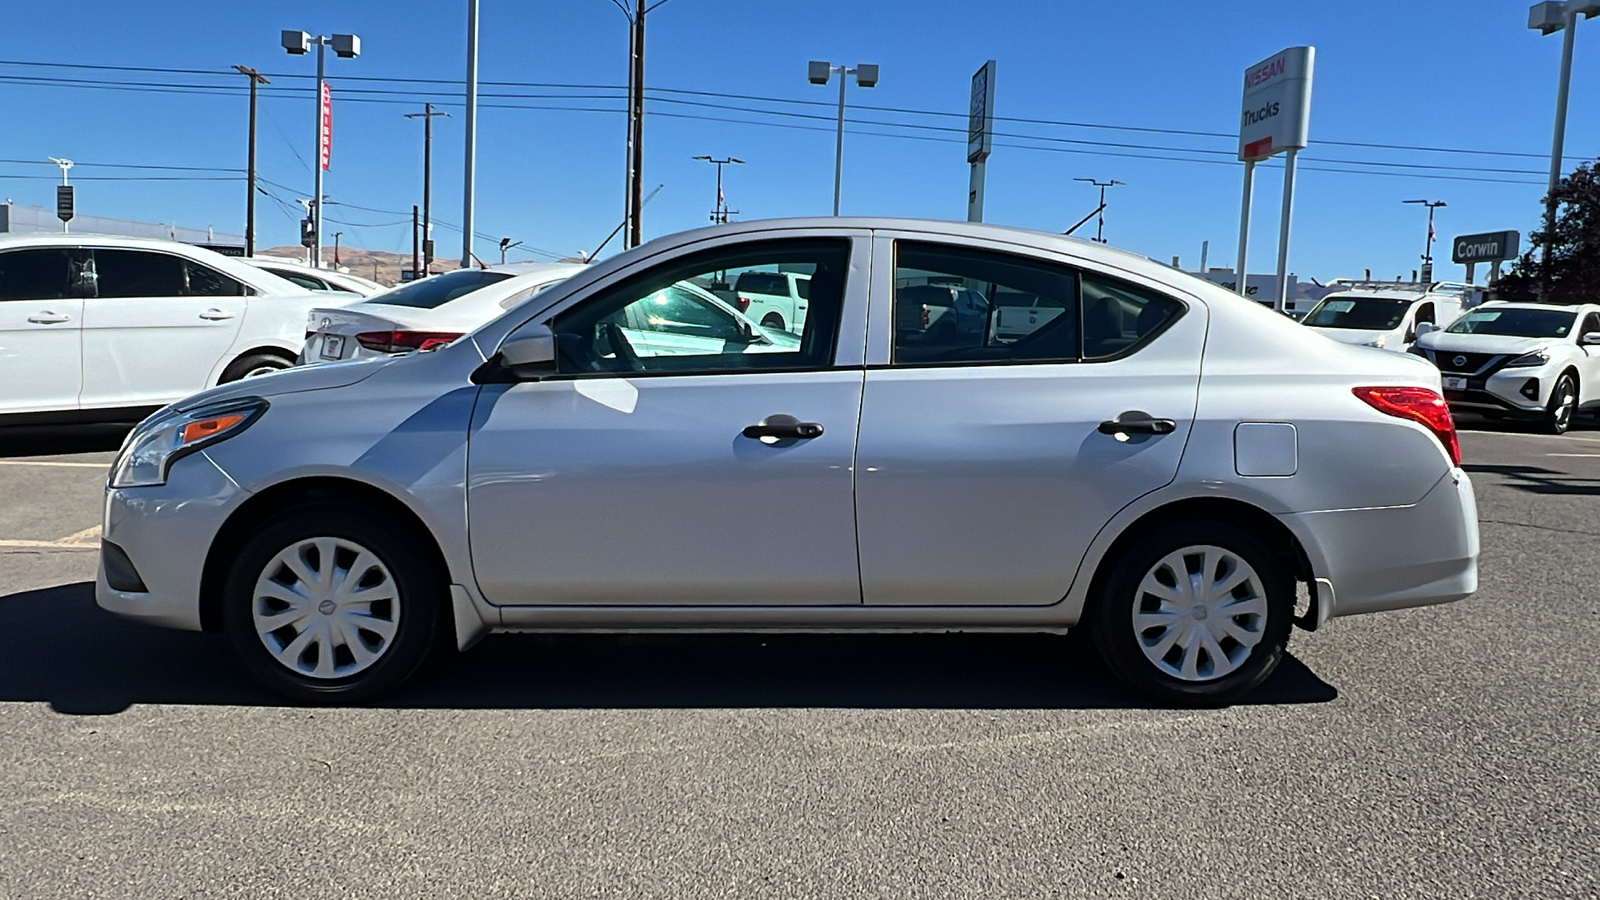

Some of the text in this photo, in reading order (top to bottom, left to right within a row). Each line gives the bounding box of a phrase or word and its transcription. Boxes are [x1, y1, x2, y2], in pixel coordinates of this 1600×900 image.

[1245, 58, 1285, 88] NISSAN
[1243, 101, 1280, 127] Trucks
[322, 106, 330, 166] NISSAN
[1457, 237, 1498, 258] Corwin
